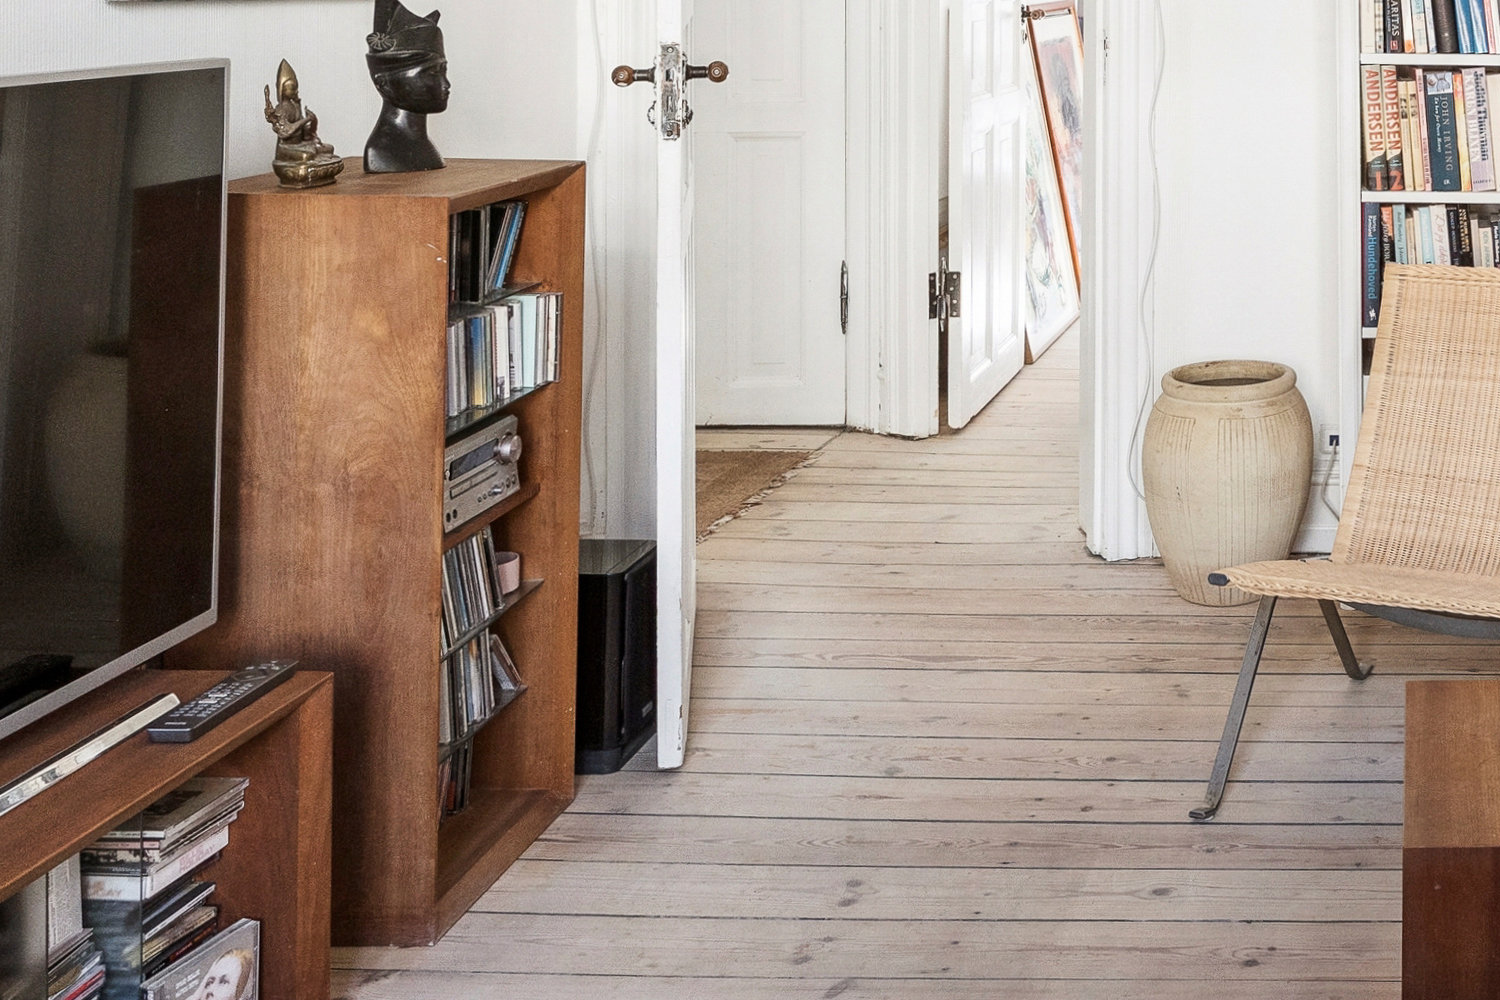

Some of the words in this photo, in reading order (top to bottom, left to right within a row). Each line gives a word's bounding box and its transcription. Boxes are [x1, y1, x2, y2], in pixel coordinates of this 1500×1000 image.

[1365, 69, 1384, 152] ANDERSEN
[1383, 69, 1401, 150] ANDERSEN
[1464, 73, 1476, 116] KAREN
[1474, 71, 1486, 107] Judith
[1440, 96, 1450, 126] JOHN
[1444, 131, 1453, 171] IRVING
[1467, 119, 1480, 162] BLIXEN
[1389, 170, 1403, 190] 2
[1368, 237, 1377, 299] Hundehoved
